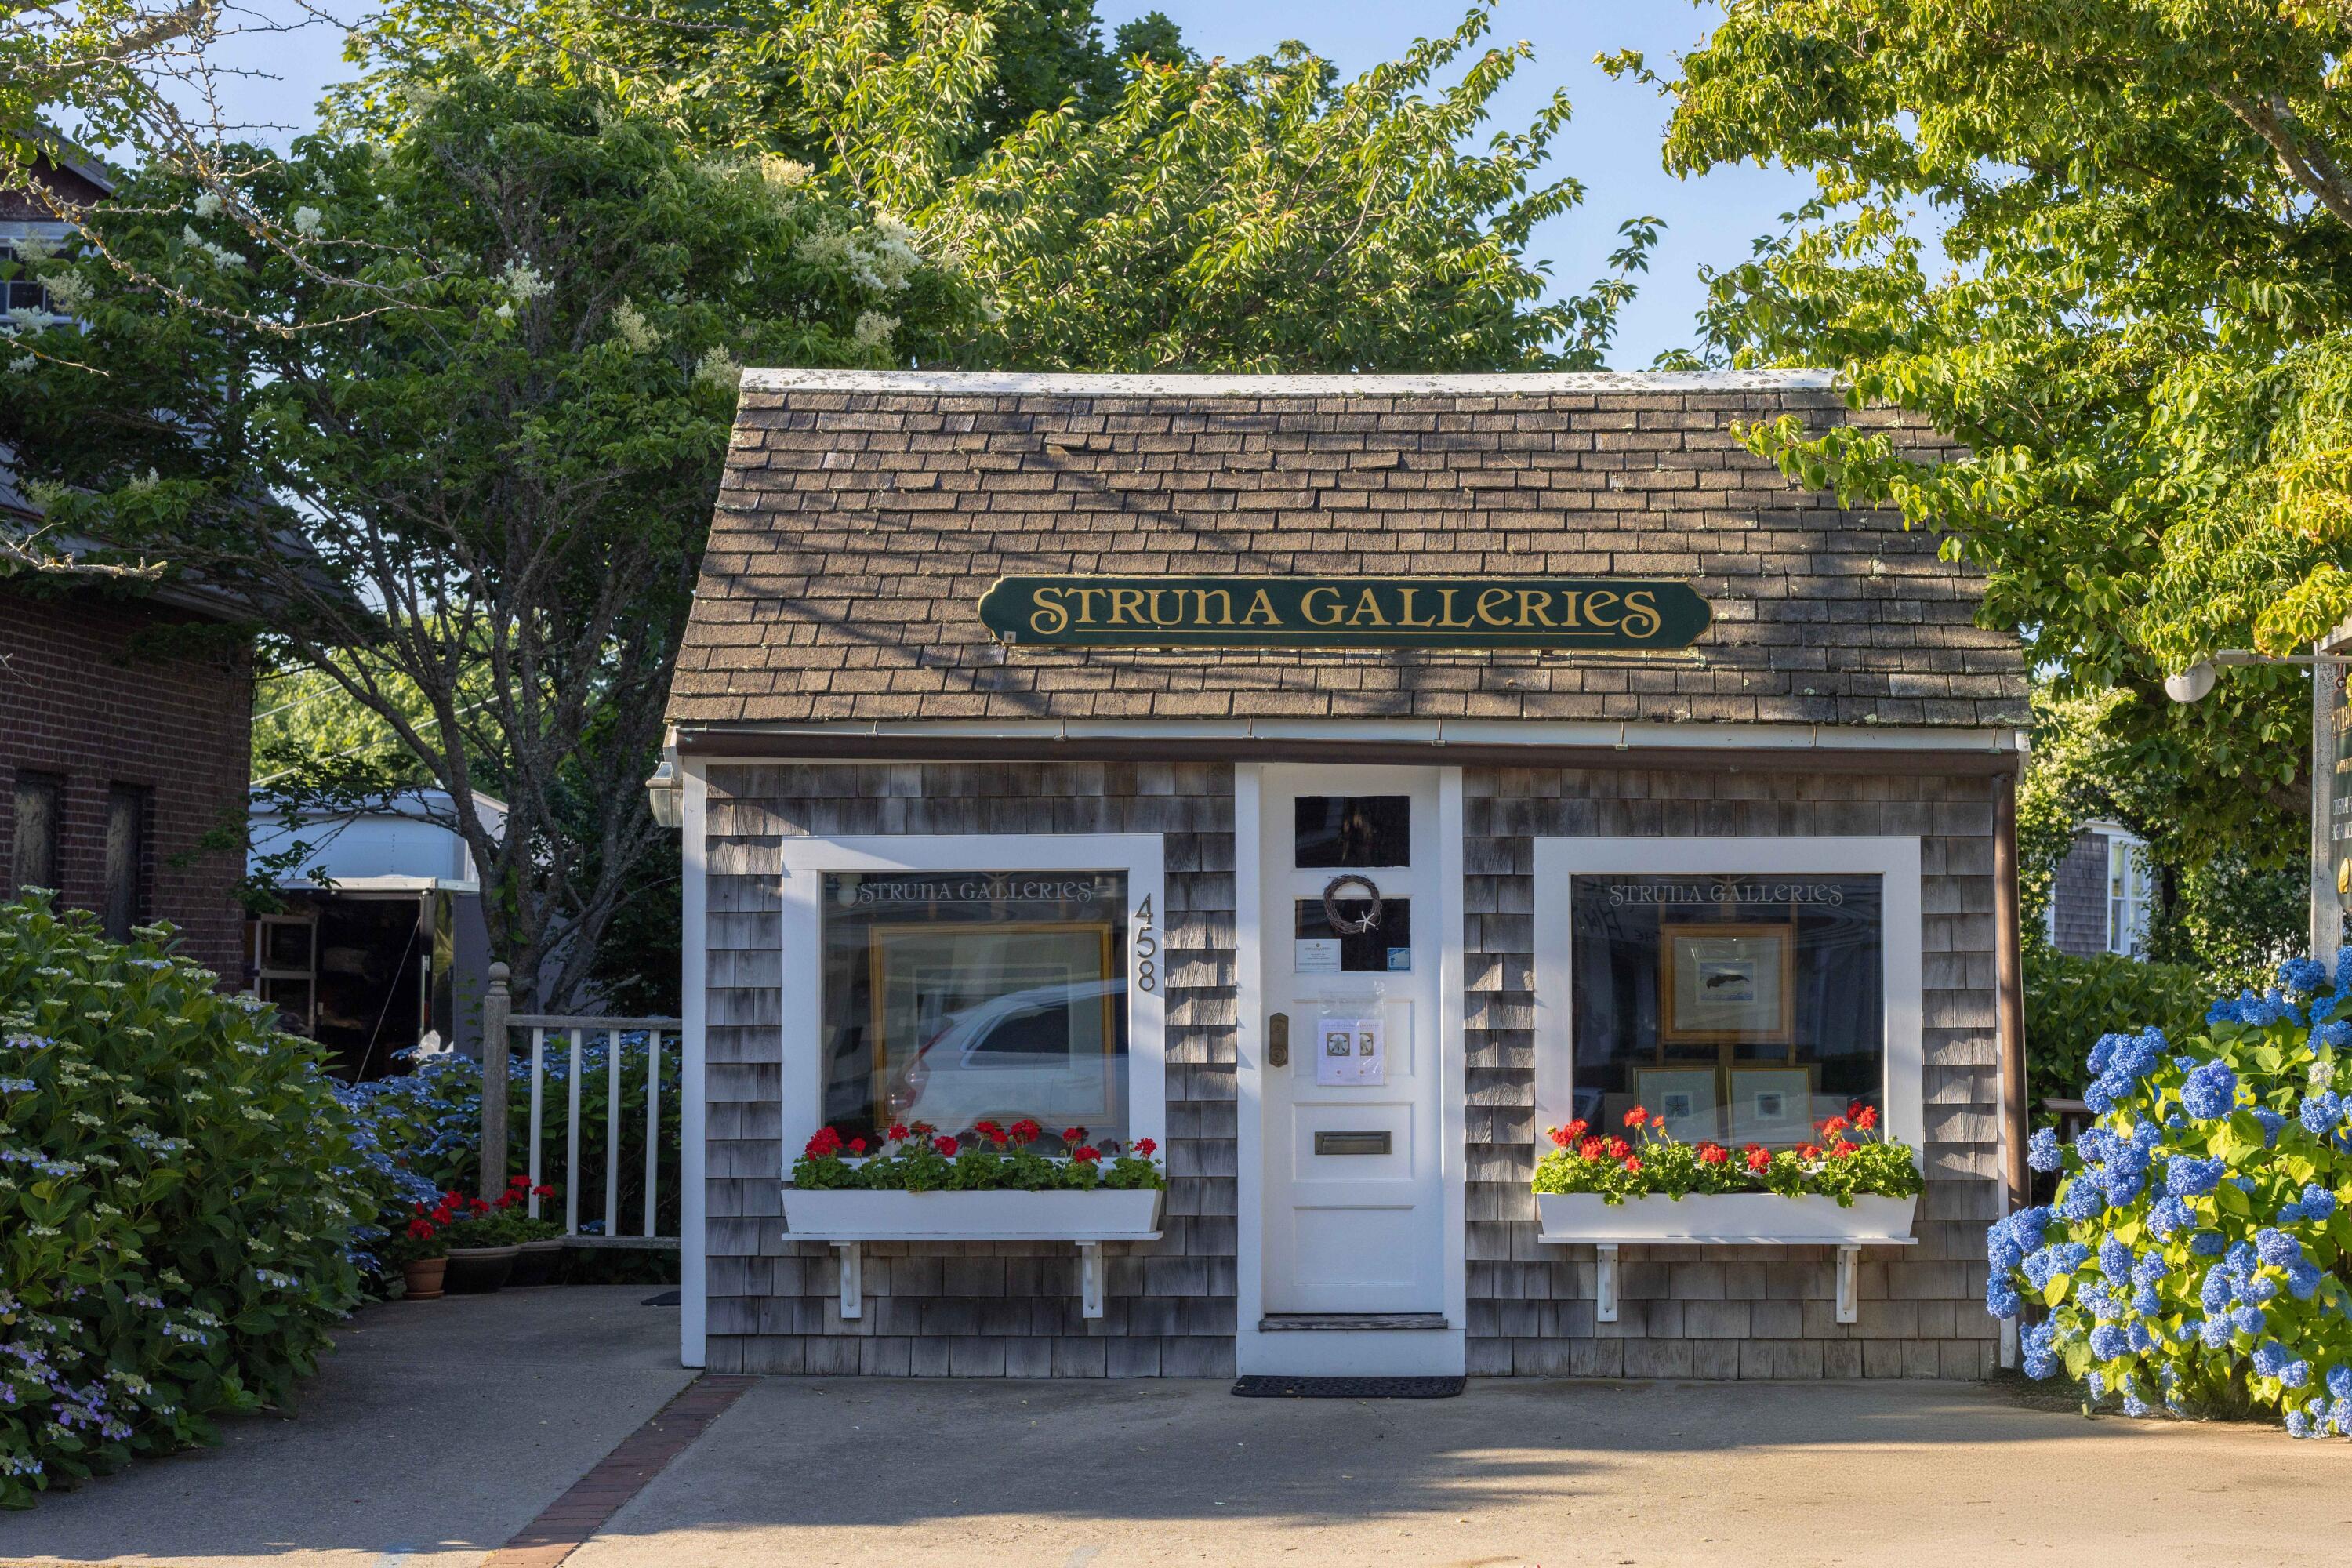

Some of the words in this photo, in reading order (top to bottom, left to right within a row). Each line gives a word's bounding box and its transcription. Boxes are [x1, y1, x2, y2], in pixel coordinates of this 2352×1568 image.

[1029, 586, 1285, 635] STRUNA
[1301, 586, 1661, 639] GALLERIES
[857, 881, 954, 904] STRUNA
[959, 880, 1093, 903] GALLERIES
[1609, 884, 1703, 907] STRUNA
[1710, 883, 1843, 906] GALLERIES
[1134, 892, 1156, 993] 458
